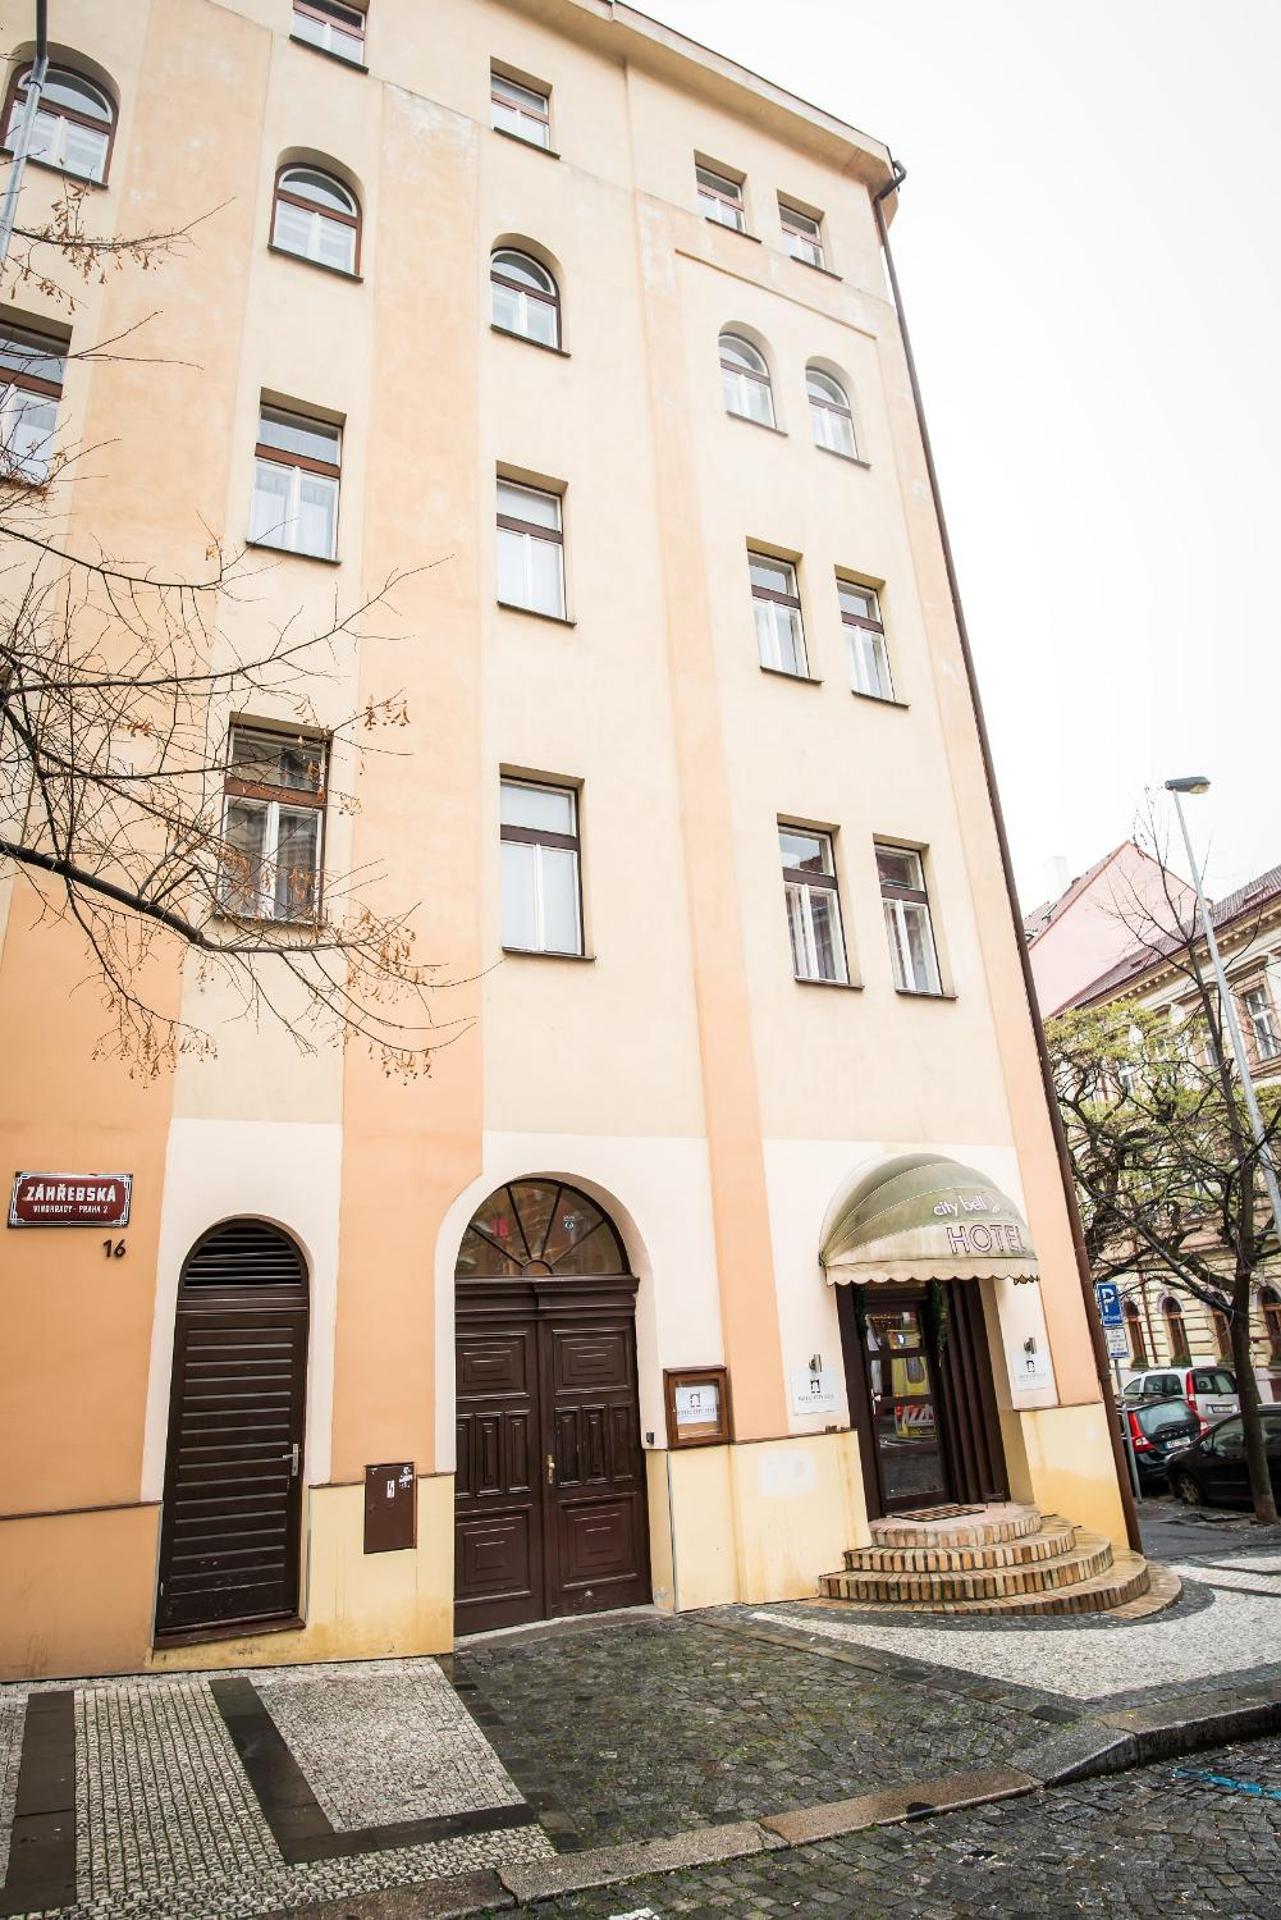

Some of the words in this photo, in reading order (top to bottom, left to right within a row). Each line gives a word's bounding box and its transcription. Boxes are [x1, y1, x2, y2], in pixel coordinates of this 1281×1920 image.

[26, 1184, 116, 1202] ZÁHŘEBSKÁ
[79, 1205, 101, 1213] PRAHA
[933, 1200, 958, 1217] city
[959, 1195, 988, 1211] bell
[103, 1239, 126, 1258] 16
[946, 1224, 1027, 1255] HOTEL
